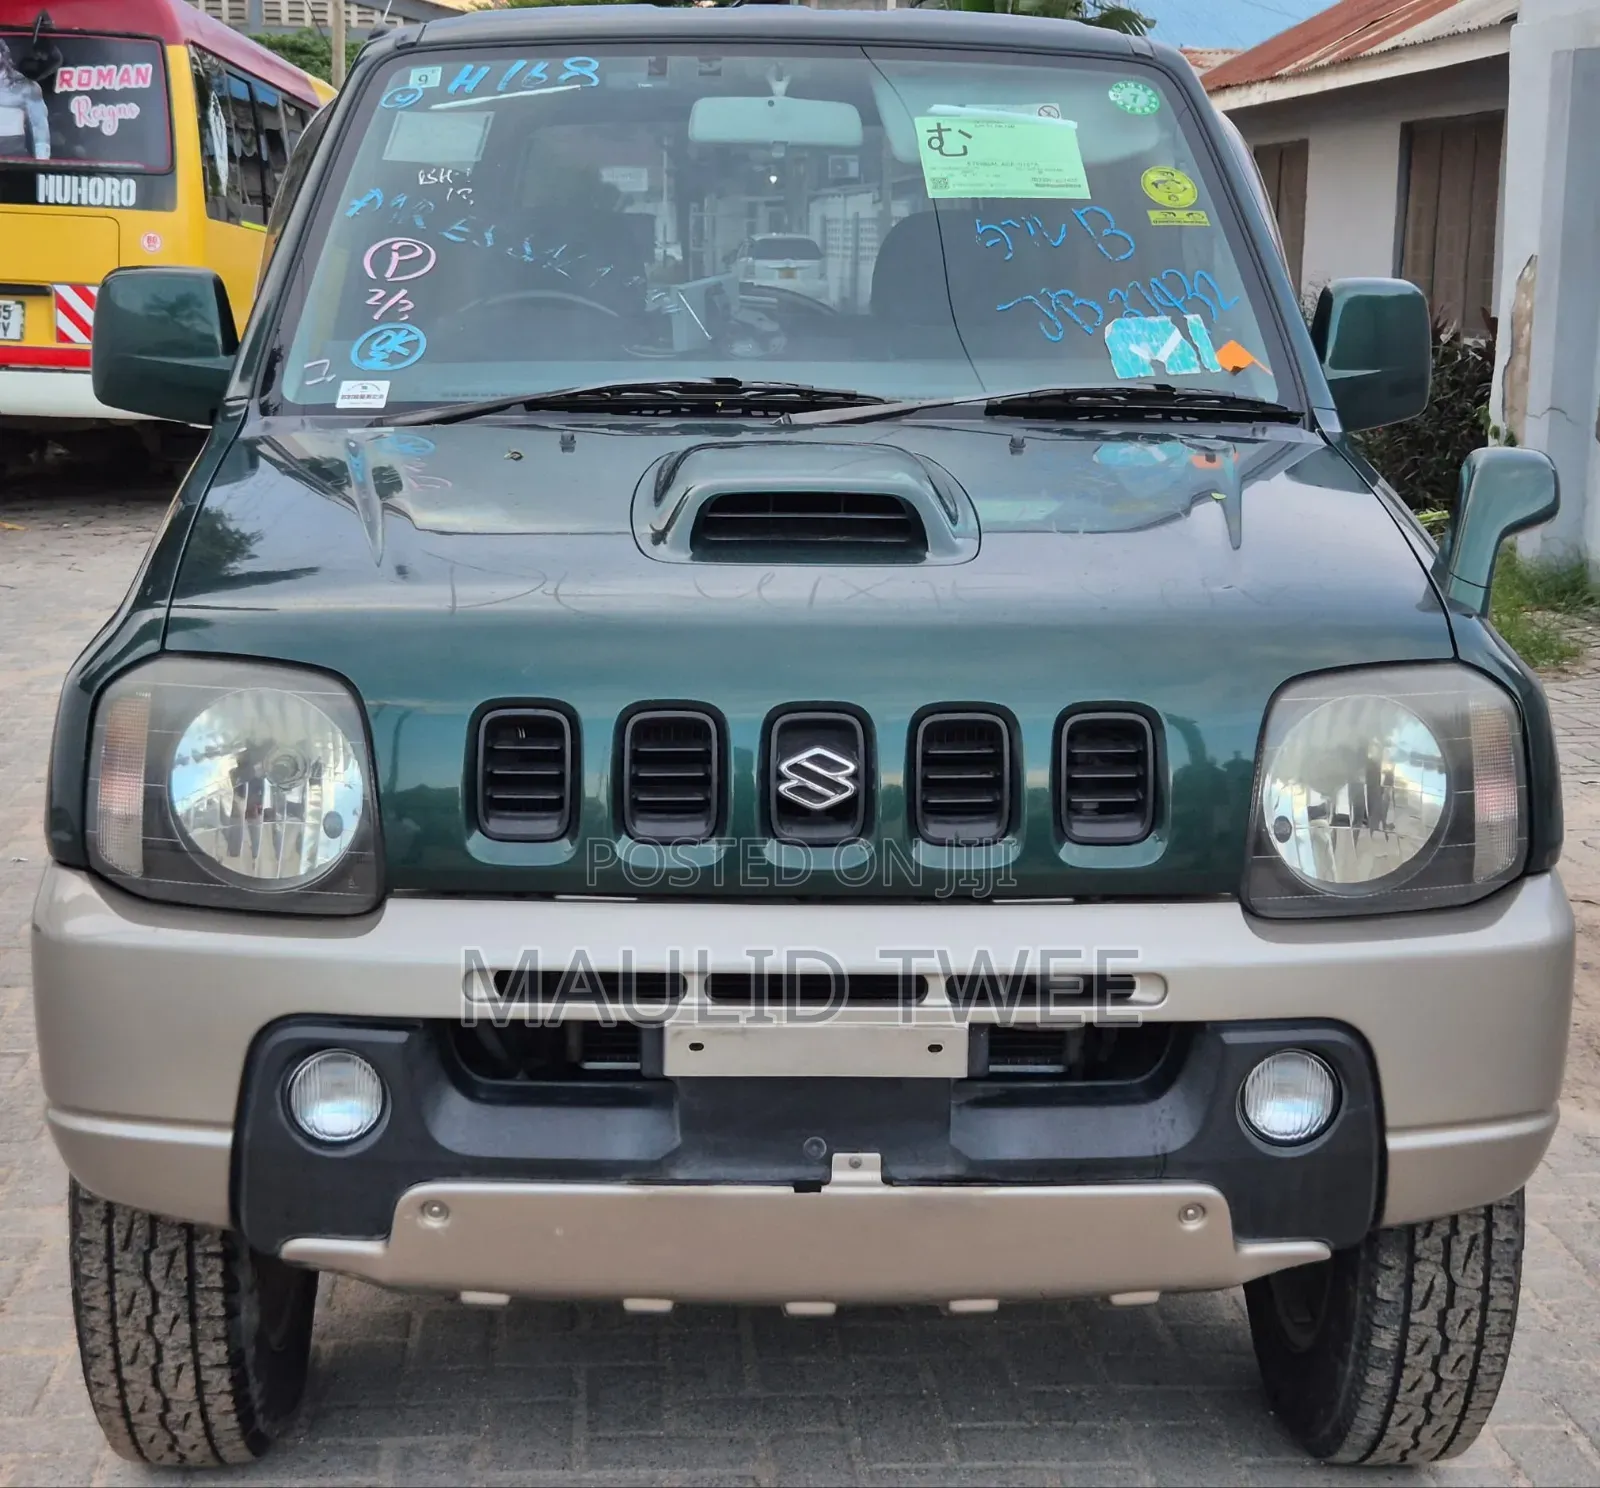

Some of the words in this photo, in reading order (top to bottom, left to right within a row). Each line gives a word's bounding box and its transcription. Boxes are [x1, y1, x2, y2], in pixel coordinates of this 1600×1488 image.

[56, 65, 152, 92] ROMAN
[926, 122, 973, 157] む
[37, 174, 137, 206] MUHORO
[0, 321, 11, 337] Y
